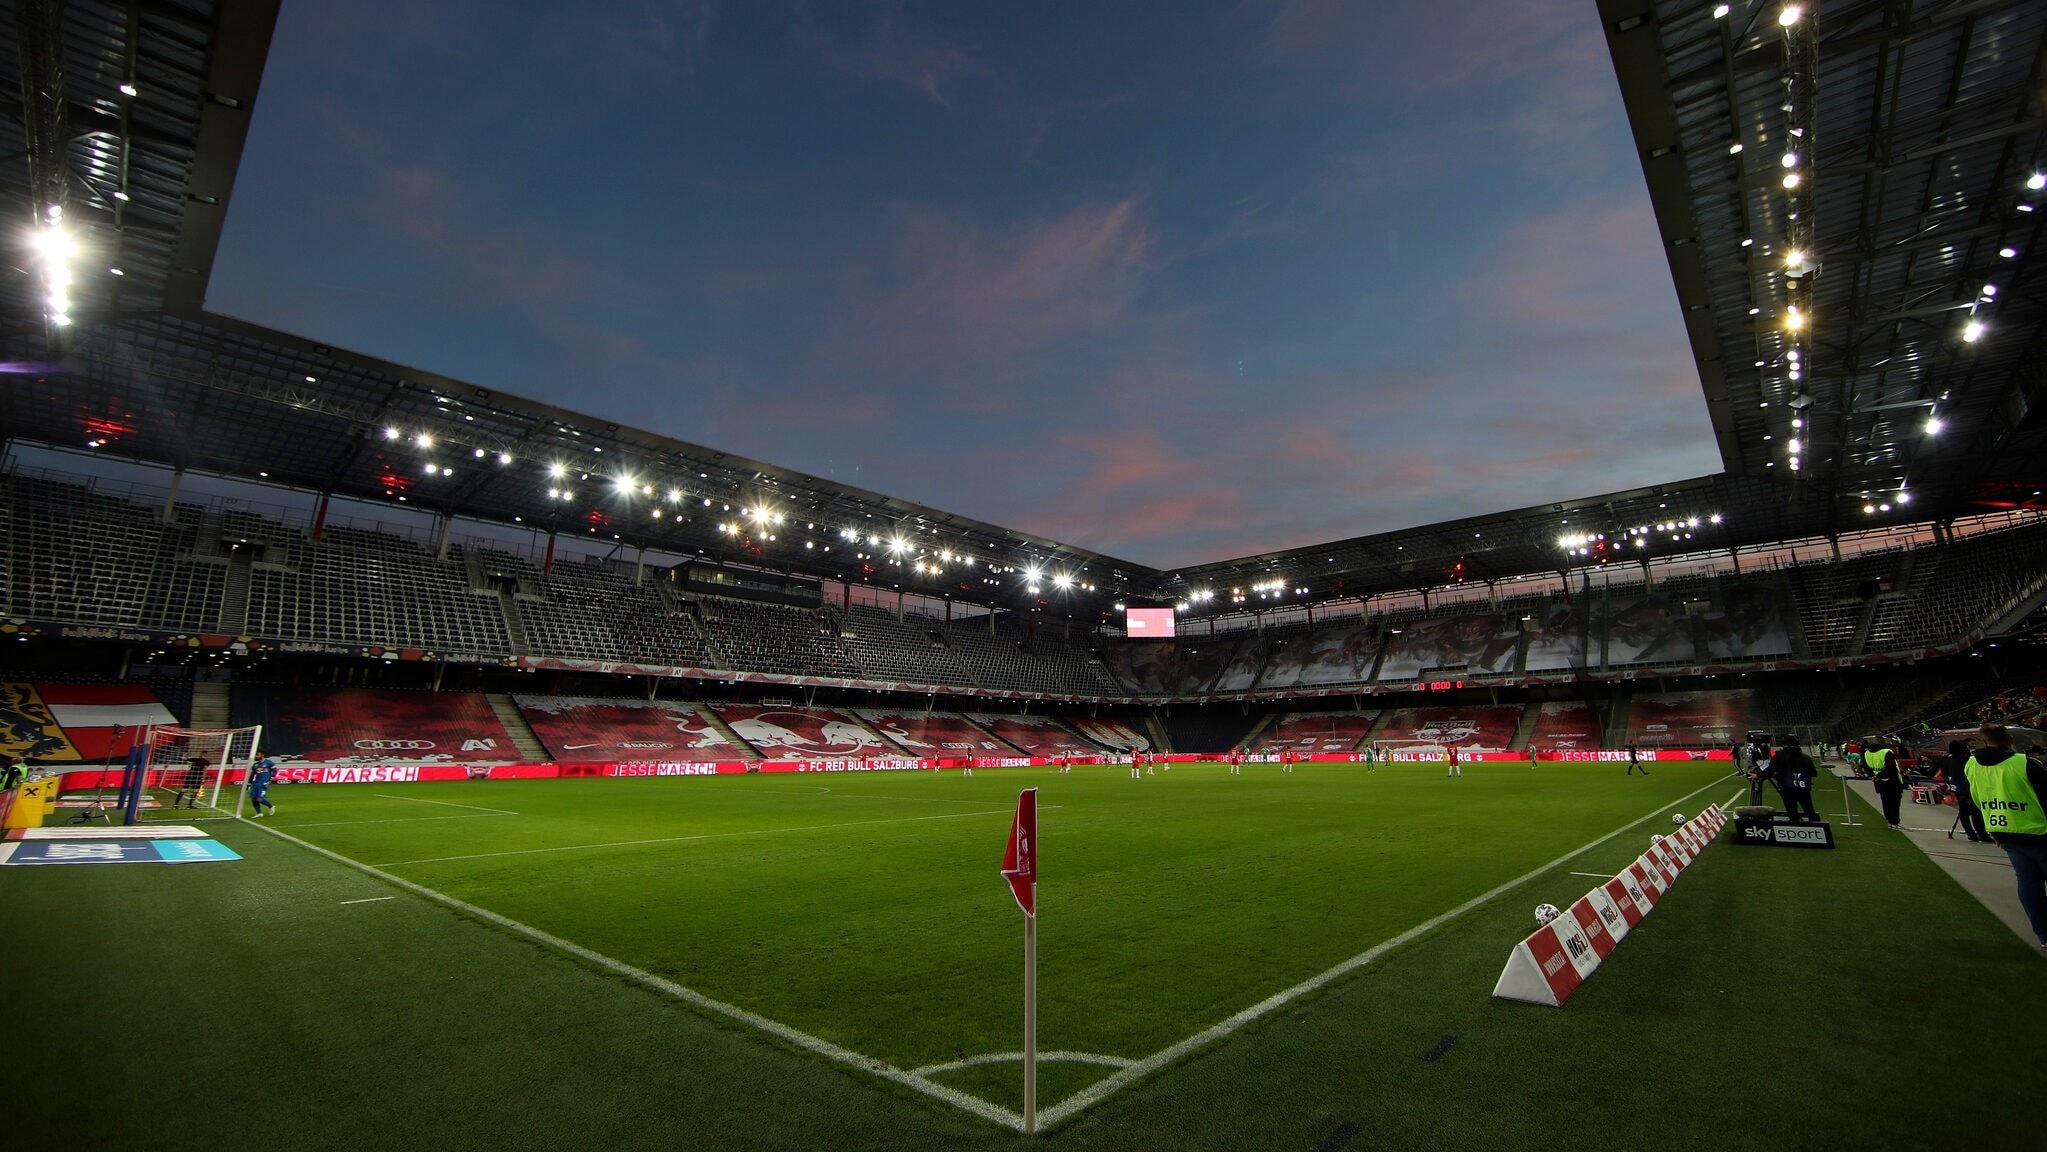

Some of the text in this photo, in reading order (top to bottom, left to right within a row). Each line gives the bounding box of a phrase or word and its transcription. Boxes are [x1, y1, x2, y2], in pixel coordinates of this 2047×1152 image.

[461, 738, 498, 751] A1
[1393, 753, 1418, 762] BULL
[1419, 753, 1471, 762] SALZRG
[1560, 751, 1656, 761] JESSE MARCH
[609, 764, 656, 777] JESSE
[656, 763, 717, 776] MARSCH
[810, 759, 919, 772] FC RED BULL SALZBURG
[322, 767, 420, 783] MARSCH
[1981, 798, 2029, 812] rdner
[1989, 814, 2008, 827] 68
[1744, 825, 1823, 841] sky sport
